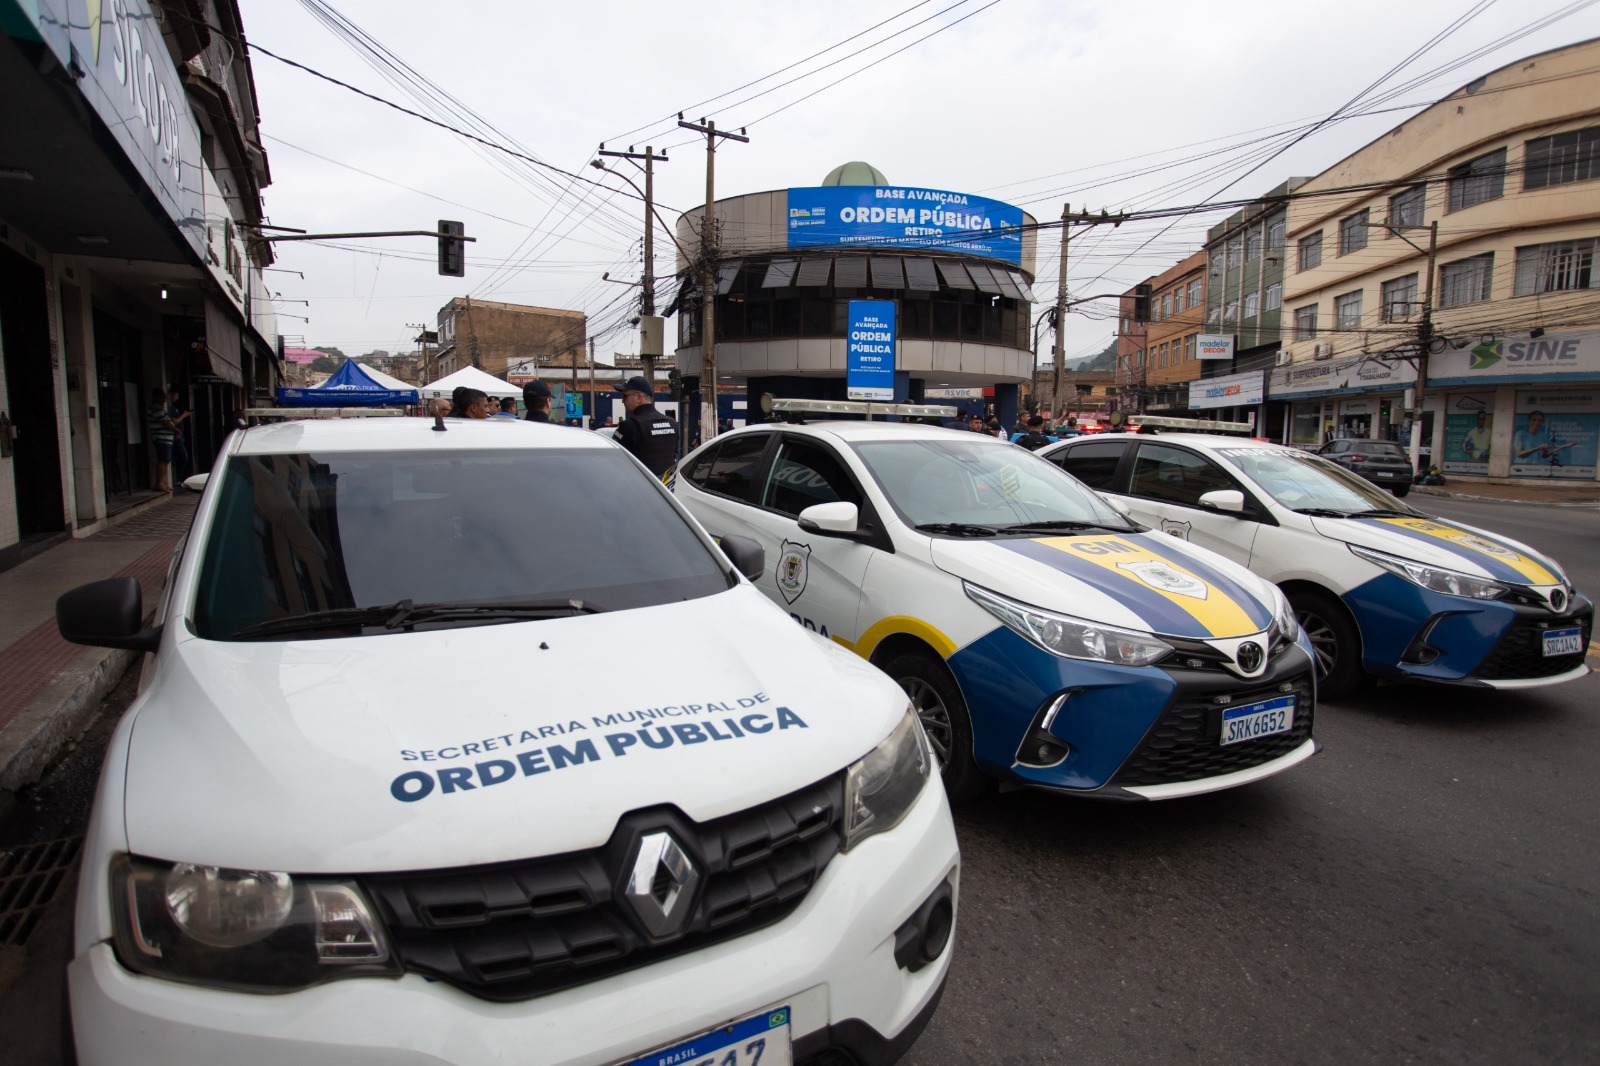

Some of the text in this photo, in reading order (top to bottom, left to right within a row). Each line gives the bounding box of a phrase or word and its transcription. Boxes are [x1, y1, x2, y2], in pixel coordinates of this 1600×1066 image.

[876, 189, 968, 205] BASE AVANÇADA
[840, 207, 915, 224] ORDEM
[920, 205, 993, 234] PÚBLICA
[904, 226, 943, 237] RETIRO
[851, 331, 891, 342] ORDEM
[851, 342, 891, 353] PÚBLICA
[1070, 540, 1141, 555] GM
[1546, 637, 1578, 654] SRC1A42
[400, 692, 770, 762] SECRETARIA MUNICIPAL DE
[1228, 710, 1286, 741] SRK6G52
[390, 706, 810, 803] ORDEM PÚBLICA
[658, 1047, 697, 1066] BRASIL
